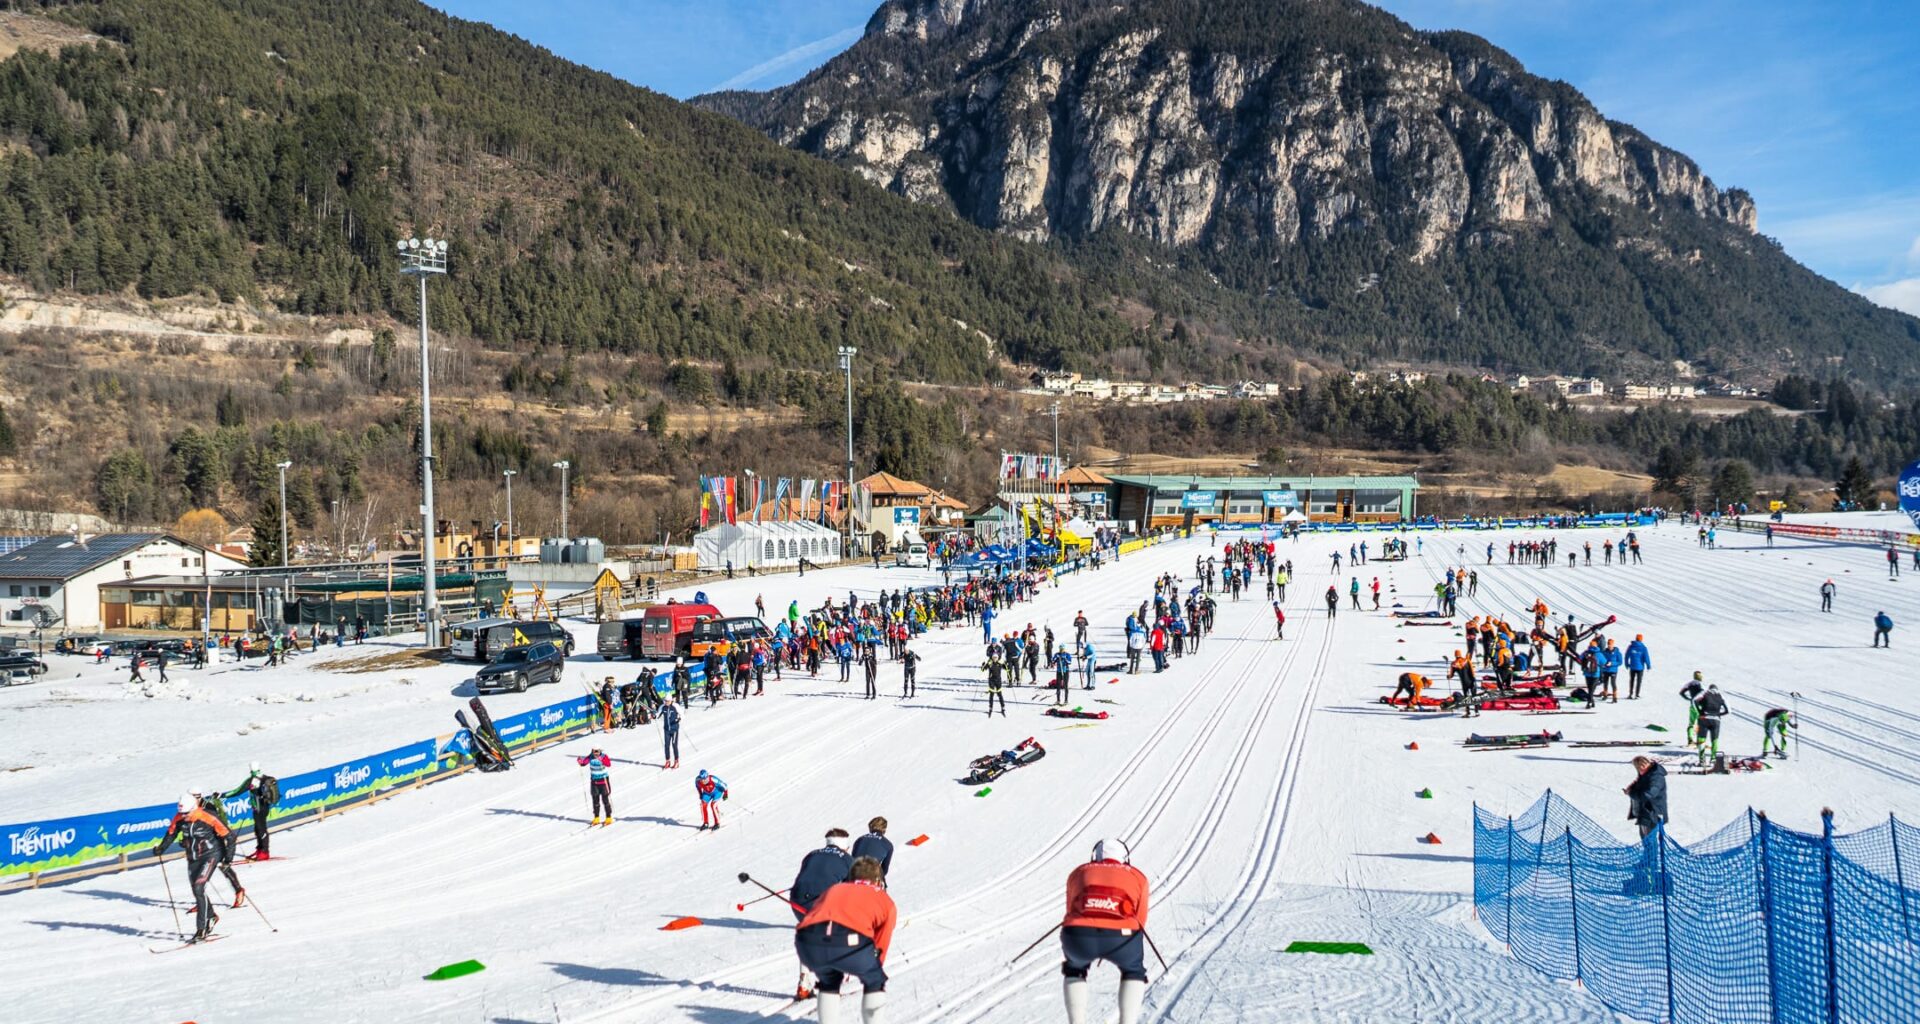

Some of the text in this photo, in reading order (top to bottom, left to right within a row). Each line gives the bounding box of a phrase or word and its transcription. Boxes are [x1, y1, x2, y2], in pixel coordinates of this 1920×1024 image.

[1899, 477, 1920, 497] TRE
[334, 765, 371, 789] TRENTINO
[224, 798, 251, 817] NTINO
[117, 818, 171, 835] fiemme
[9, 826, 76, 856] TRENTINO
